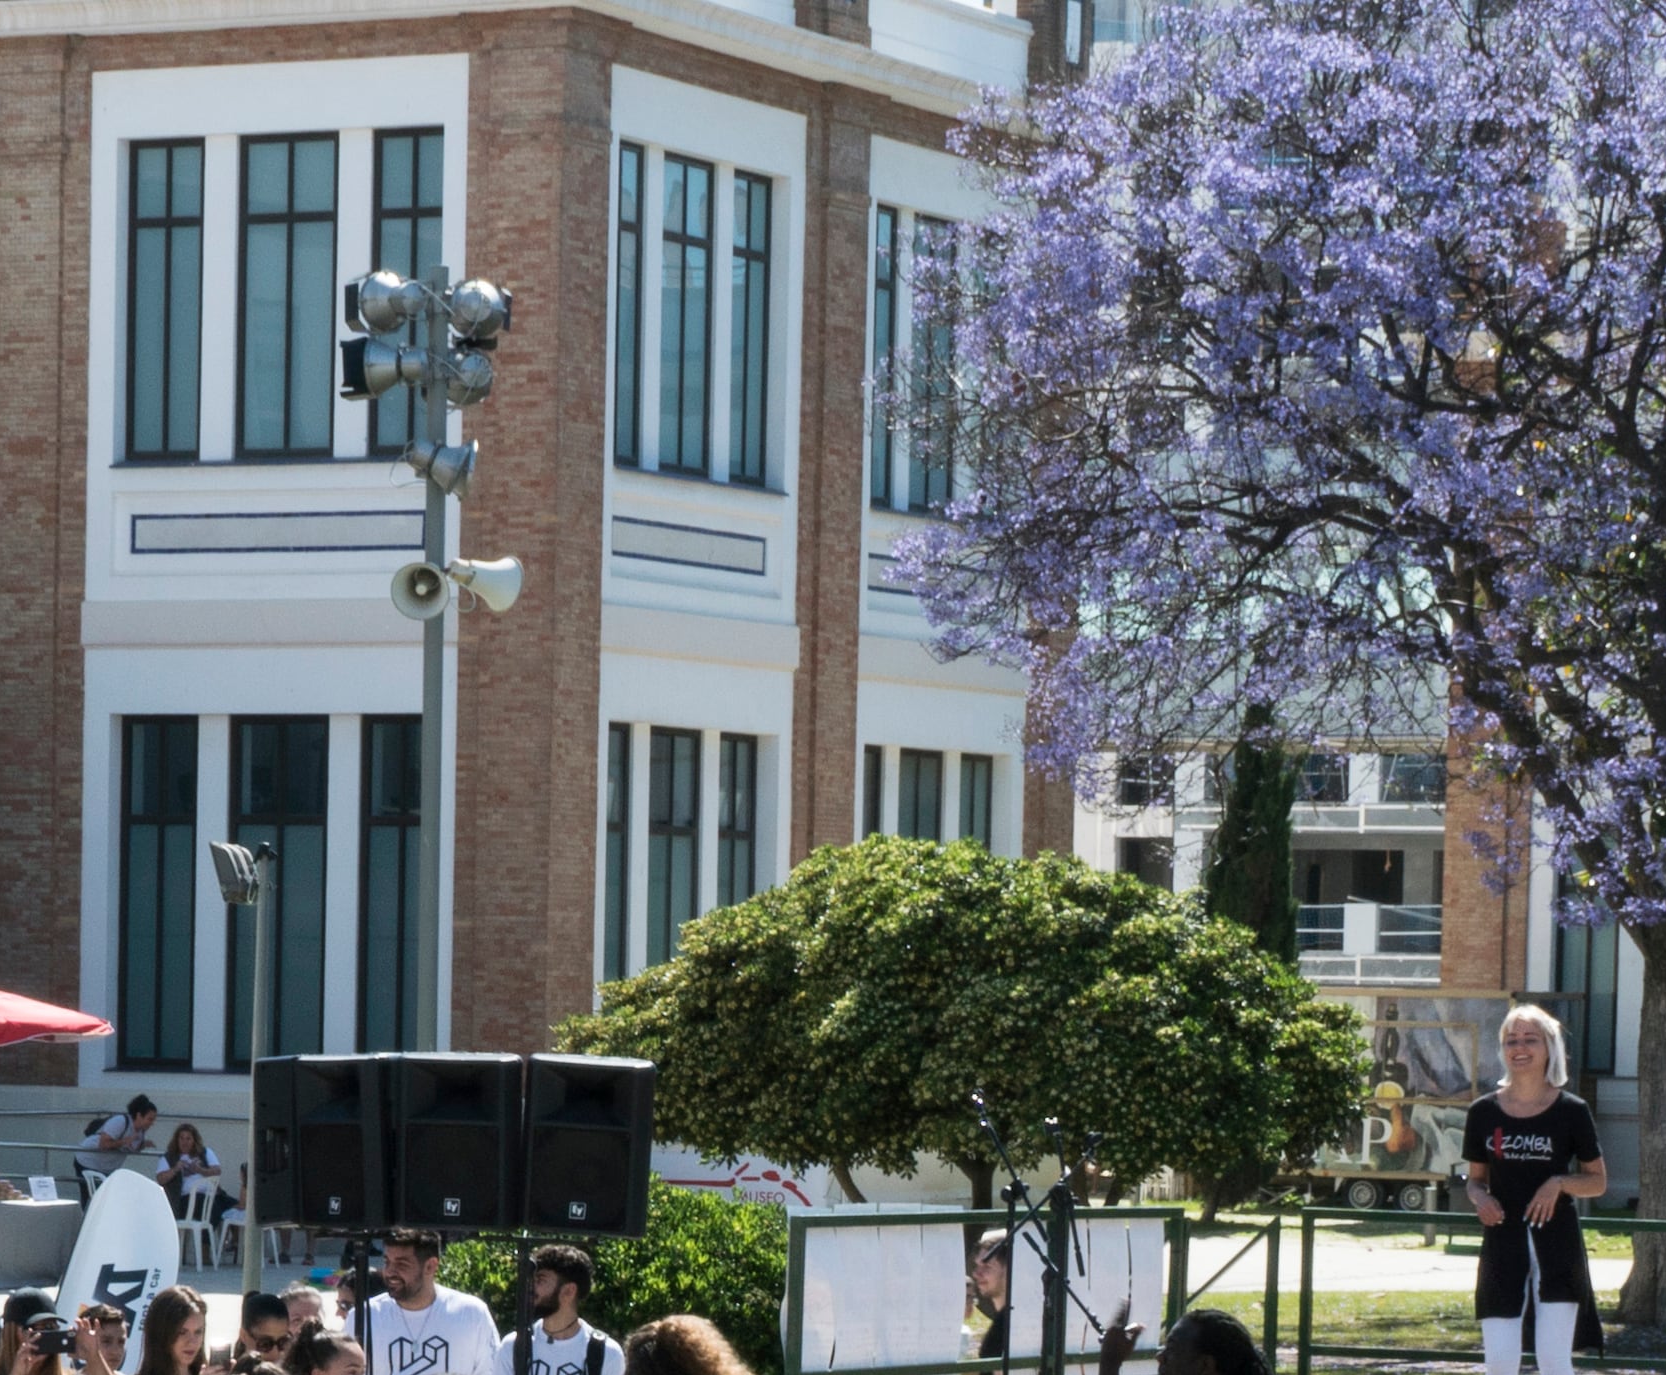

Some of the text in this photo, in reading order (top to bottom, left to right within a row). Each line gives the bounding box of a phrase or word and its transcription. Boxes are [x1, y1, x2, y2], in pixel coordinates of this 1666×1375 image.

[740, 1191, 785, 1204] MUSEO
[150, 1268, 161, 1288] car
[146, 1292, 155, 1300] a
